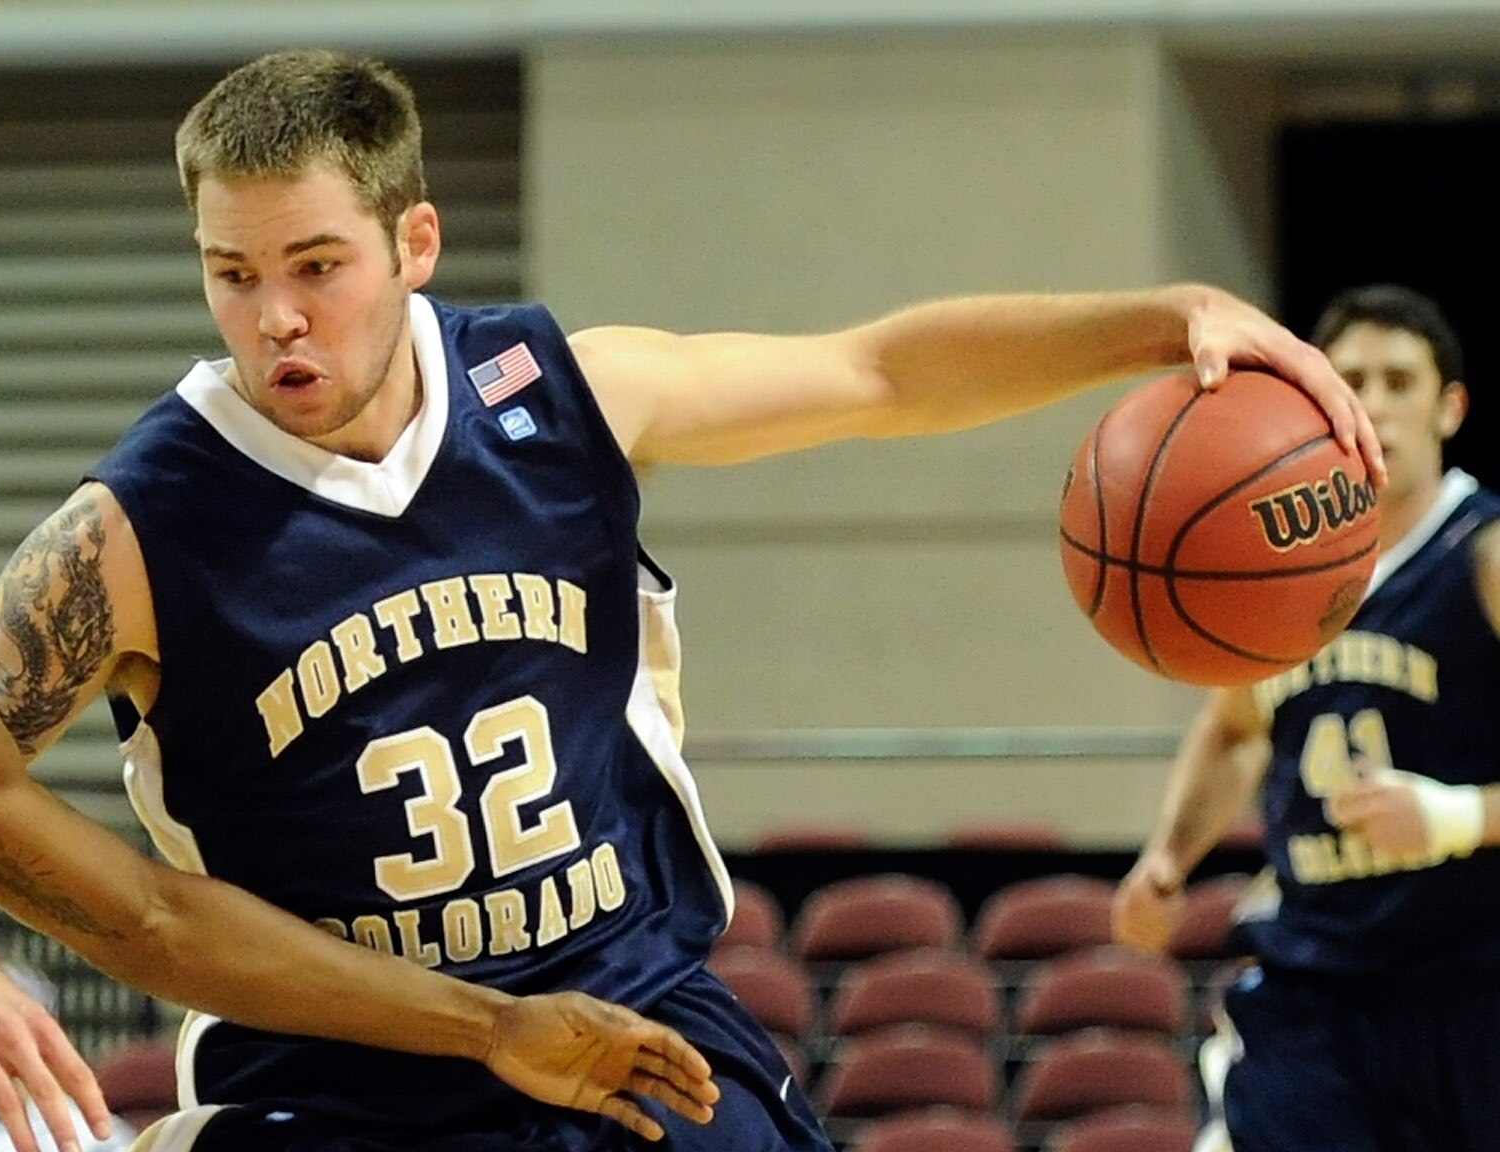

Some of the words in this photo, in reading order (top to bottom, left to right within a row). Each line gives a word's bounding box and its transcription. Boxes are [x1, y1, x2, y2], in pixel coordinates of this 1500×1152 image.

[1249, 466, 1378, 553] Wilso
[256, 573, 588, 758] NORTHERN
[355, 695, 581, 901] 32
